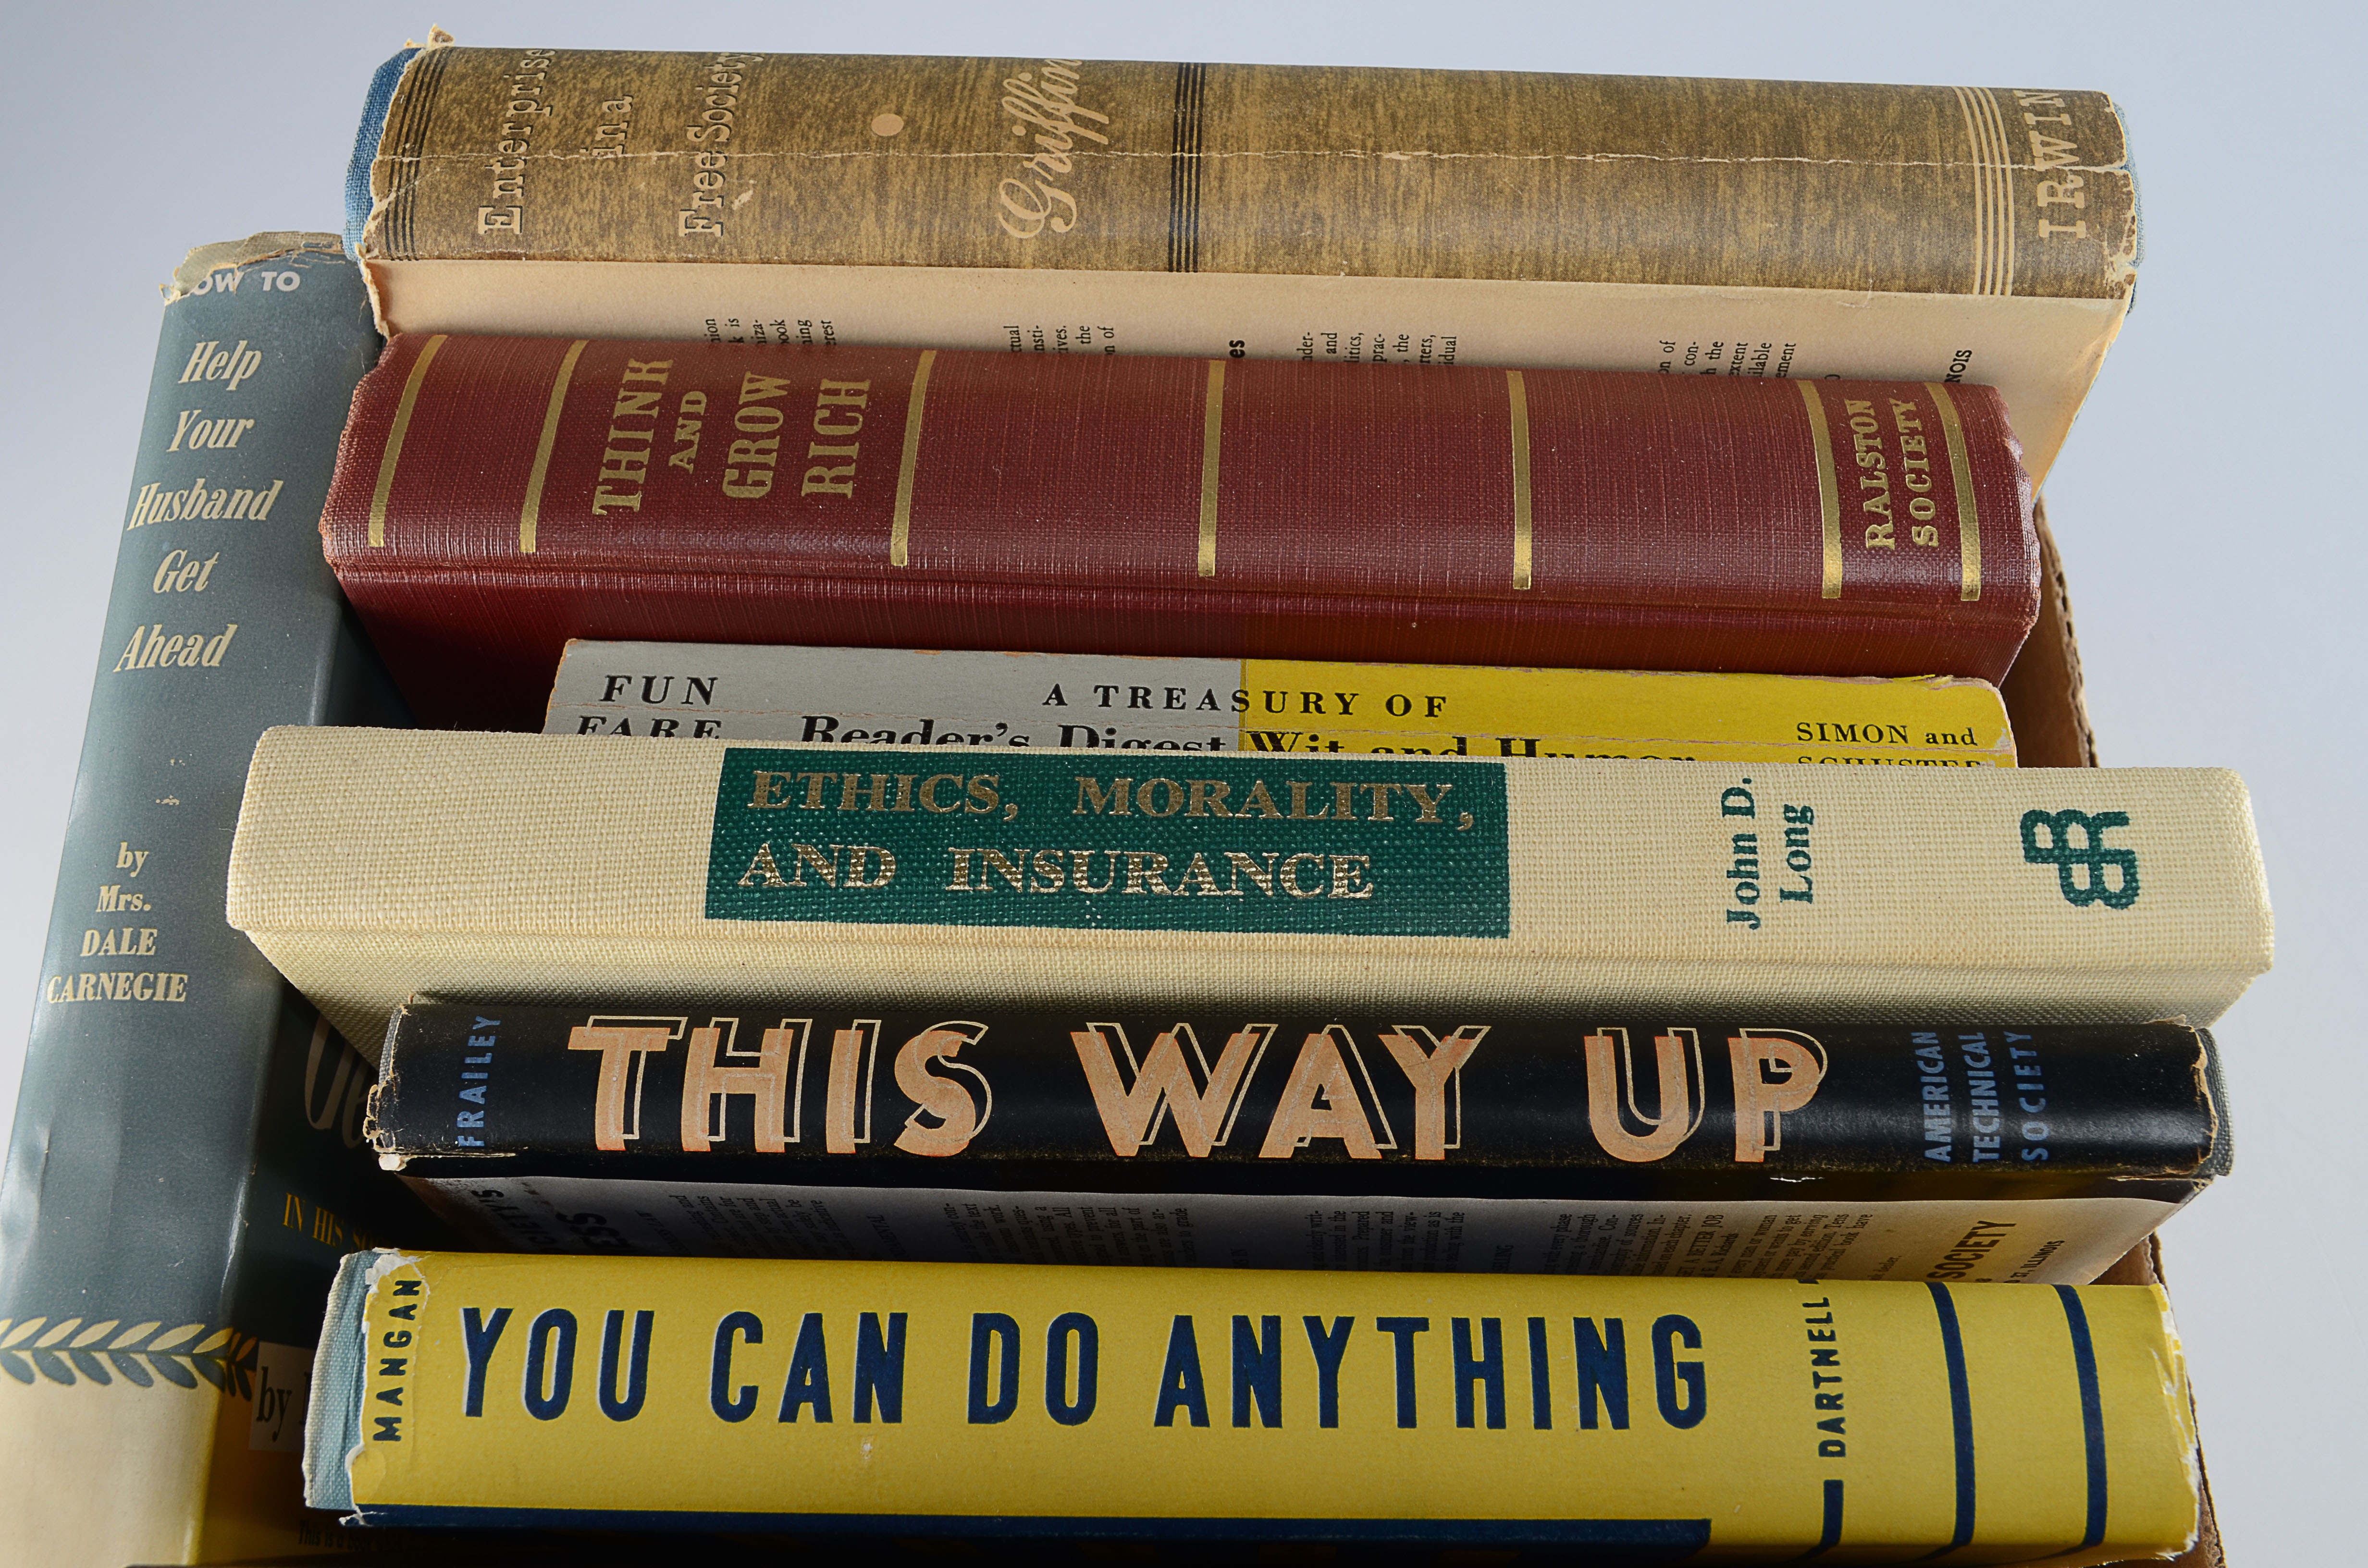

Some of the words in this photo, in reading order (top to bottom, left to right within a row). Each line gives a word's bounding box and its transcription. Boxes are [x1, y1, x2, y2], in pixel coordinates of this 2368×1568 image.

[602, 94, 633, 114] a
[687, 52, 764, 143] Society
[478, 49, 557, 234] Enterprise
[580, 120, 629, 157] in
[998, 59, 1109, 239] Griffin
[2013, 89, 2086, 239] IRWIN
[678, 150, 728, 236] Free
[193, 271, 245, 295] OW
[261, 271, 300, 292] TO
[725, 318, 740, 328] is
[1076, 326, 1091, 344] the
[1098, 326, 1115, 339] of
[1321, 332, 1337, 354] and
[1372, 332, 1387, 363] prac-
[1393, 332, 1410, 353] the
[1659, 340, 1676, 353] of
[1683, 341, 1699, 366] con-
[1705, 341, 1724, 360] the
[178, 340, 262, 391] Help
[166, 409, 256, 453] Your
[592, 358, 674, 515] THINK
[668, 391, 707, 474] AND
[722, 371, 791, 499] GROW
[801, 379, 871, 499] RICH
[1844, 398, 1896, 551] RALSTON
[1889, 398, 1939, 548] SOCIETY
[127, 478, 284, 531] Husband
[153, 549, 220, 594] Get
[113, 624, 238, 673] Ahead
[599, 674, 718, 706] FUN
[1042, 683, 1068, 707] A
[1094, 684, 1359, 716] TREASURY
[1385, 693, 1447, 718] OF
[1796, 721, 1909, 745] SIMON
[1924, 727, 1978, 747] and
[747, 769, 1019, 822] ETHICS,
[1072, 776, 1475, 832] MORALITY,
[1720, 777, 1756, 820] D.
[116, 841, 149, 877] by
[1779, 804, 1815, 905] Long
[736, 843, 898, 889] AND
[944, 845, 1373, 900] INSURANCE
[1726, 833, 1761, 931] John
[96, 884, 152, 912] Mrs.
[80, 928, 158, 956] DALE
[47, 972, 188, 1003] CARNEGIE
[456, 1015, 502, 1147] FRAILEY
[567, 1015, 992, 1157] THIS
[1070, 1022, 1492, 1161] WAY
[1584, 1027, 1828, 1163] UP
[1910, 1032, 1952, 1163] AMERICAN
[1958, 1032, 2001, 1163] TECHNICAL
[2003, 1030, 2050, 1162] SOCIETY
[283, 1192, 307, 1232] IN
[668, 1195, 694, 1209] and
[717, 1196, 738, 1208] for
[737, 1198, 761, 1211] and
[759, 1198, 788, 1219] actual
[785, 1199, 802, 1208] be
[943, 1203, 960, 1219] con-
[961, 1203, 982, 1217] text
[983, 1204, 1008, 1224] work.
[1011, 1205, 1034, 1225] ques-
[1051, 1207, 1073, 1218] All
[1098, 1207, 1118, 1216] all
[1151, 1208, 1166, 1220] ar-
[1327, 1211, 1346, 1221] the
[1035, 1214, 1055, 1232] using
[1076, 1206, 1104, 1232] prevent
[1103, 1219, 1122, 1229] for
[1129, 1217, 1149, 1231] part
[1169, 1208, 1194, 1228] grade
[1304, 1210, 1322, 1228] writ-
[1351, 1211, 1374, 1240] Prepared
[1375, 1211, 1394, 1225] and
[1399, 1212, 1418, 1231] view-
[1428, 1220, 1440, 1228] as
[1445, 1212, 1465, 1223] the
[1549, 1213, 1573, 1233] phase
[1570, 1213, 1599, 1242] thorough
[1597, 1214, 1619, 1231] Con-
[1623, 1213, 1645, 1237] sources
[1646, 1214, 1666, 1225] In-
[1664, 1213, 1692, 1238] chapter.
[1782, 1214, 1802, 1225] get
[1799, 1214, 1829, 1237] earning
[1832, 1232, 1860, 1246] book
[1846, 1214, 1873, 1229] have
[1444, 1225, 1462, 1240] with
[1660, 1239, 1680, 1253] each
[1685, 1230, 1716, 1257] BETTER
[1701, 1214, 1725, 1228] JOB
[1709, 1233, 1739, 1257] Richards
[1739, 1245, 1759, 1258] man
[1753, 1214, 1778, 1237] woman
[1808, 1231, 1838, 1252] edition.
[1823, 1214, 1850, 1229] Tens
[1926, 1220, 2017, 1279] SOCIETY
[2020, 1240, 2065, 1269] ILLINOIS
[372, 1280, 422, 1442] MANGAN
[460, 1307, 656, 1423] YOU
[710, 1311, 909, 1424] CAN
[967, 1311, 1099, 1426] DO
[1154, 1313, 1708, 1430] ANYTHING
[1801, 1297, 1847, 1458] DARTNELL
[256, 1366, 292, 1443] by
